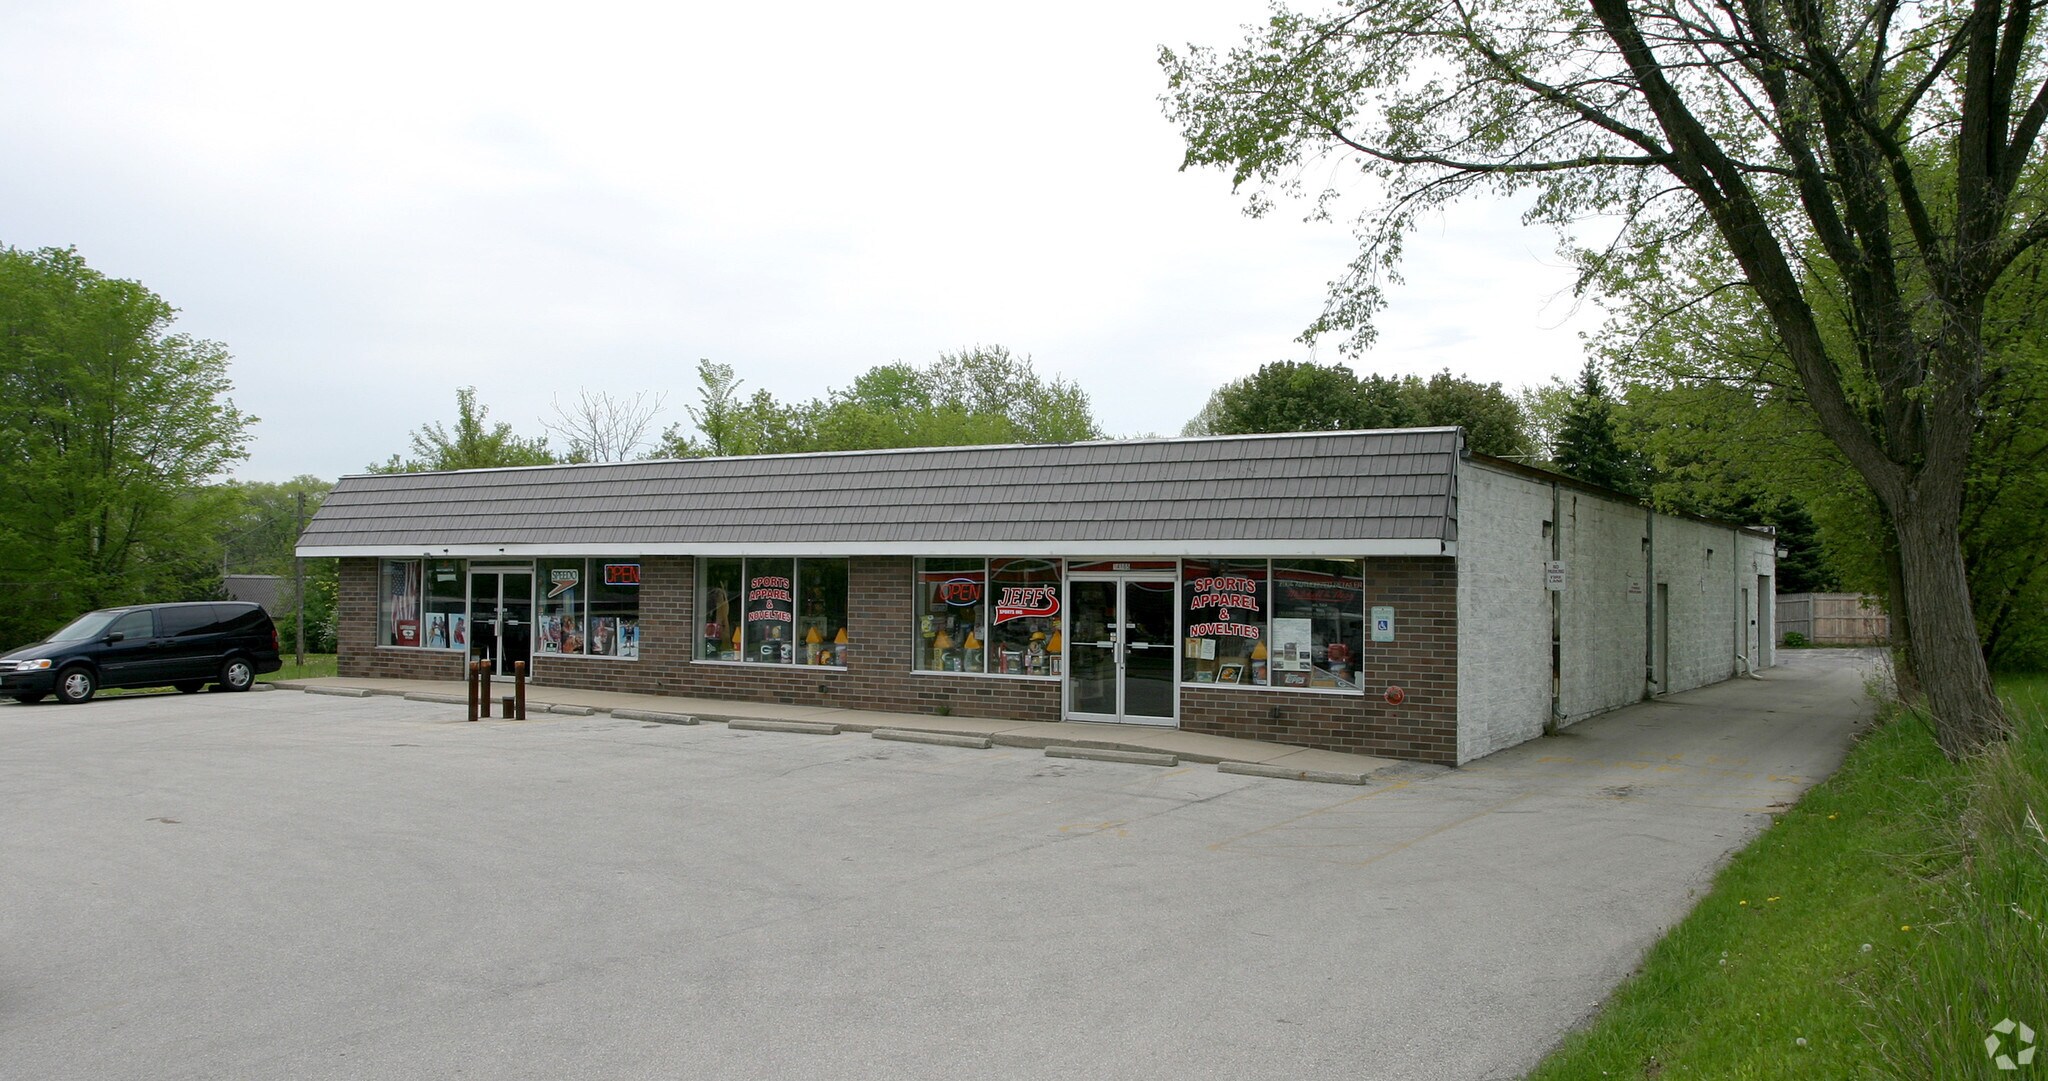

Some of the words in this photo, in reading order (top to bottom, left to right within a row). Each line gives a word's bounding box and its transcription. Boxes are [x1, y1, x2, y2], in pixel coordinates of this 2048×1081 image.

[552, 570, 577, 580] SPEEDO
[607, 565, 640, 582] OPEN
[751, 575, 790, 588] SPORTS
[1194, 577, 1256, 593] SPORTS
[749, 588, 791, 602] APPAREL
[940, 583, 980, 600] OPEN
[998, 584, 1059, 608] JEFF'S
[766, 600, 774, 609] &
[1191, 593, 1259, 611] APPAREL
[748, 610, 792, 622] NOVELTIES
[1219, 608, 1230, 620] &
[1190, 622, 1259, 640] NOVELTIES
